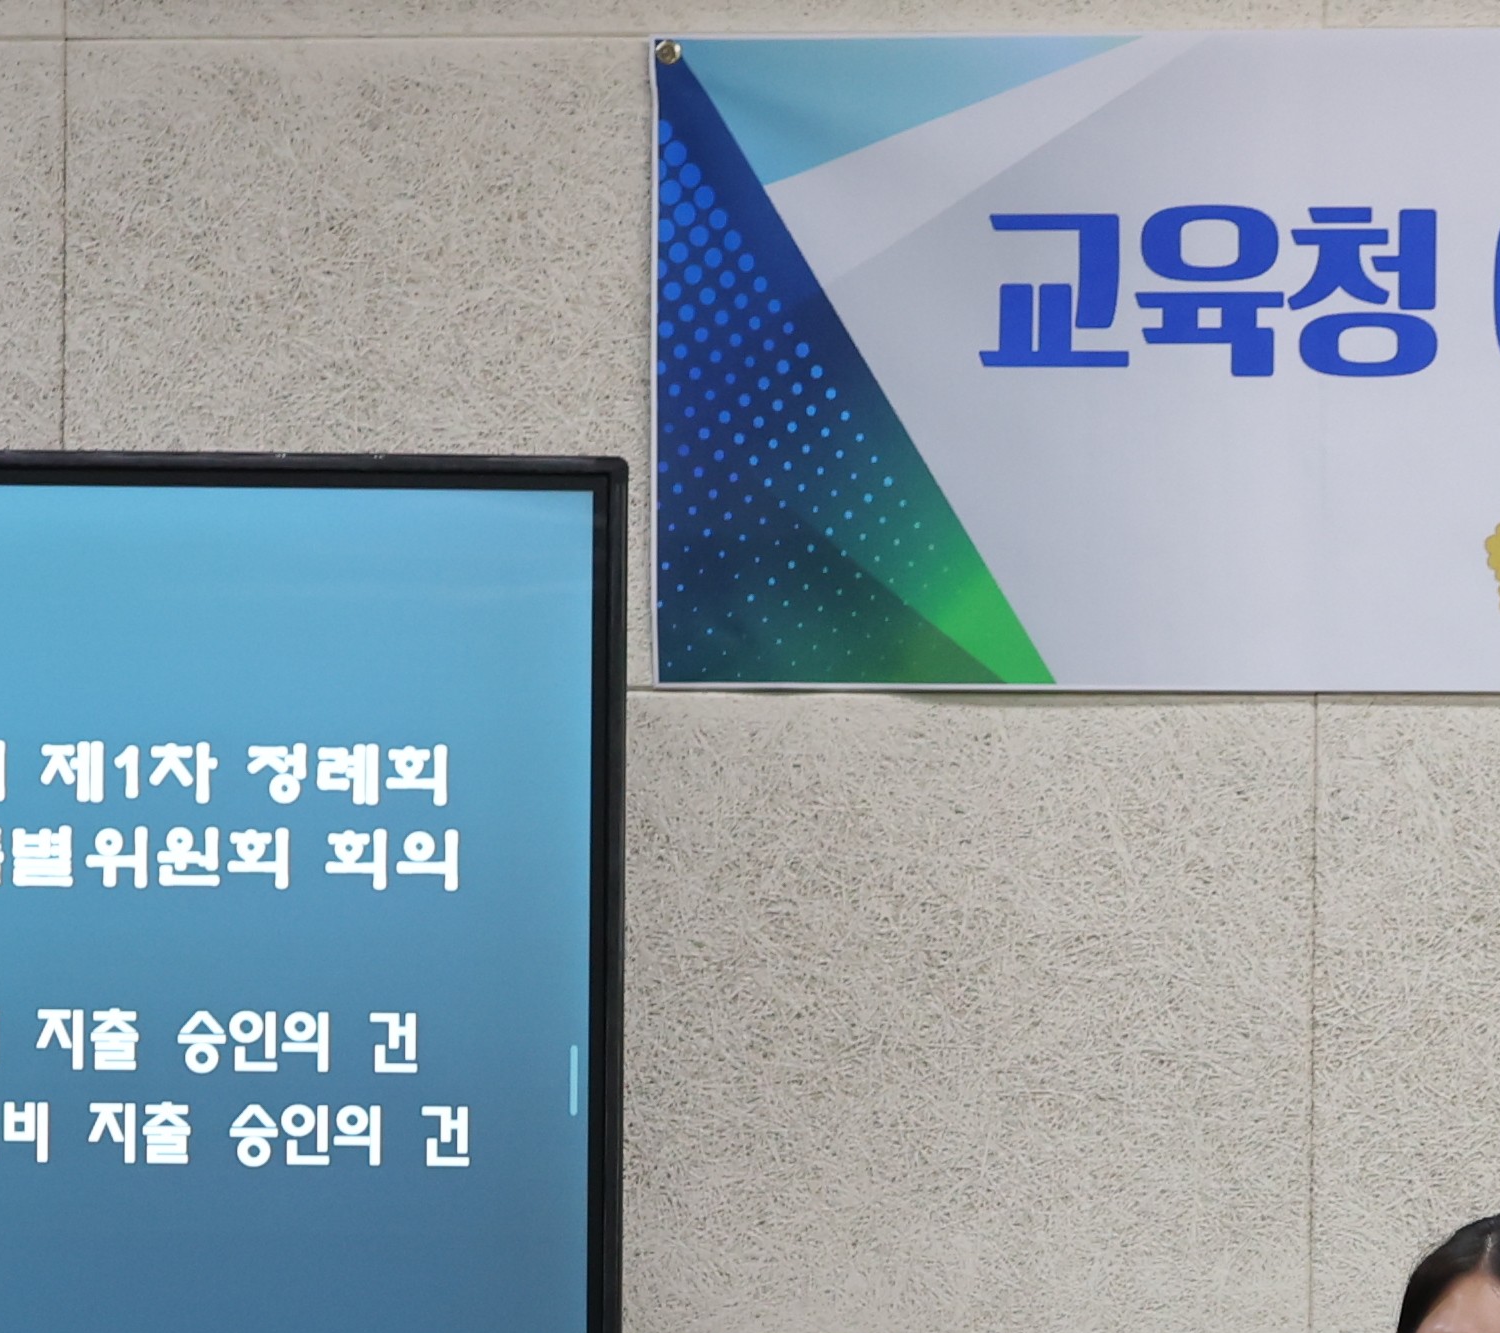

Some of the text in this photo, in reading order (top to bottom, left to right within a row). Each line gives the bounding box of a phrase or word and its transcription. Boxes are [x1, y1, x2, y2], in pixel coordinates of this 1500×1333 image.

[979, 204, 1439, 378] 교육청
[40, 740, 218, 804] 제1차
[247, 742, 448, 807] 정례회
[325, 828, 459, 891] 회의
[36, 1007, 139, 1071] 지출
[177, 1010, 329, 1074] 승인의
[369, 1012, 418, 1073] 건
[88, 1101, 191, 1164] 지출
[229, 1104, 381, 1167] 승인의
[421, 1105, 470, 1167] 건
